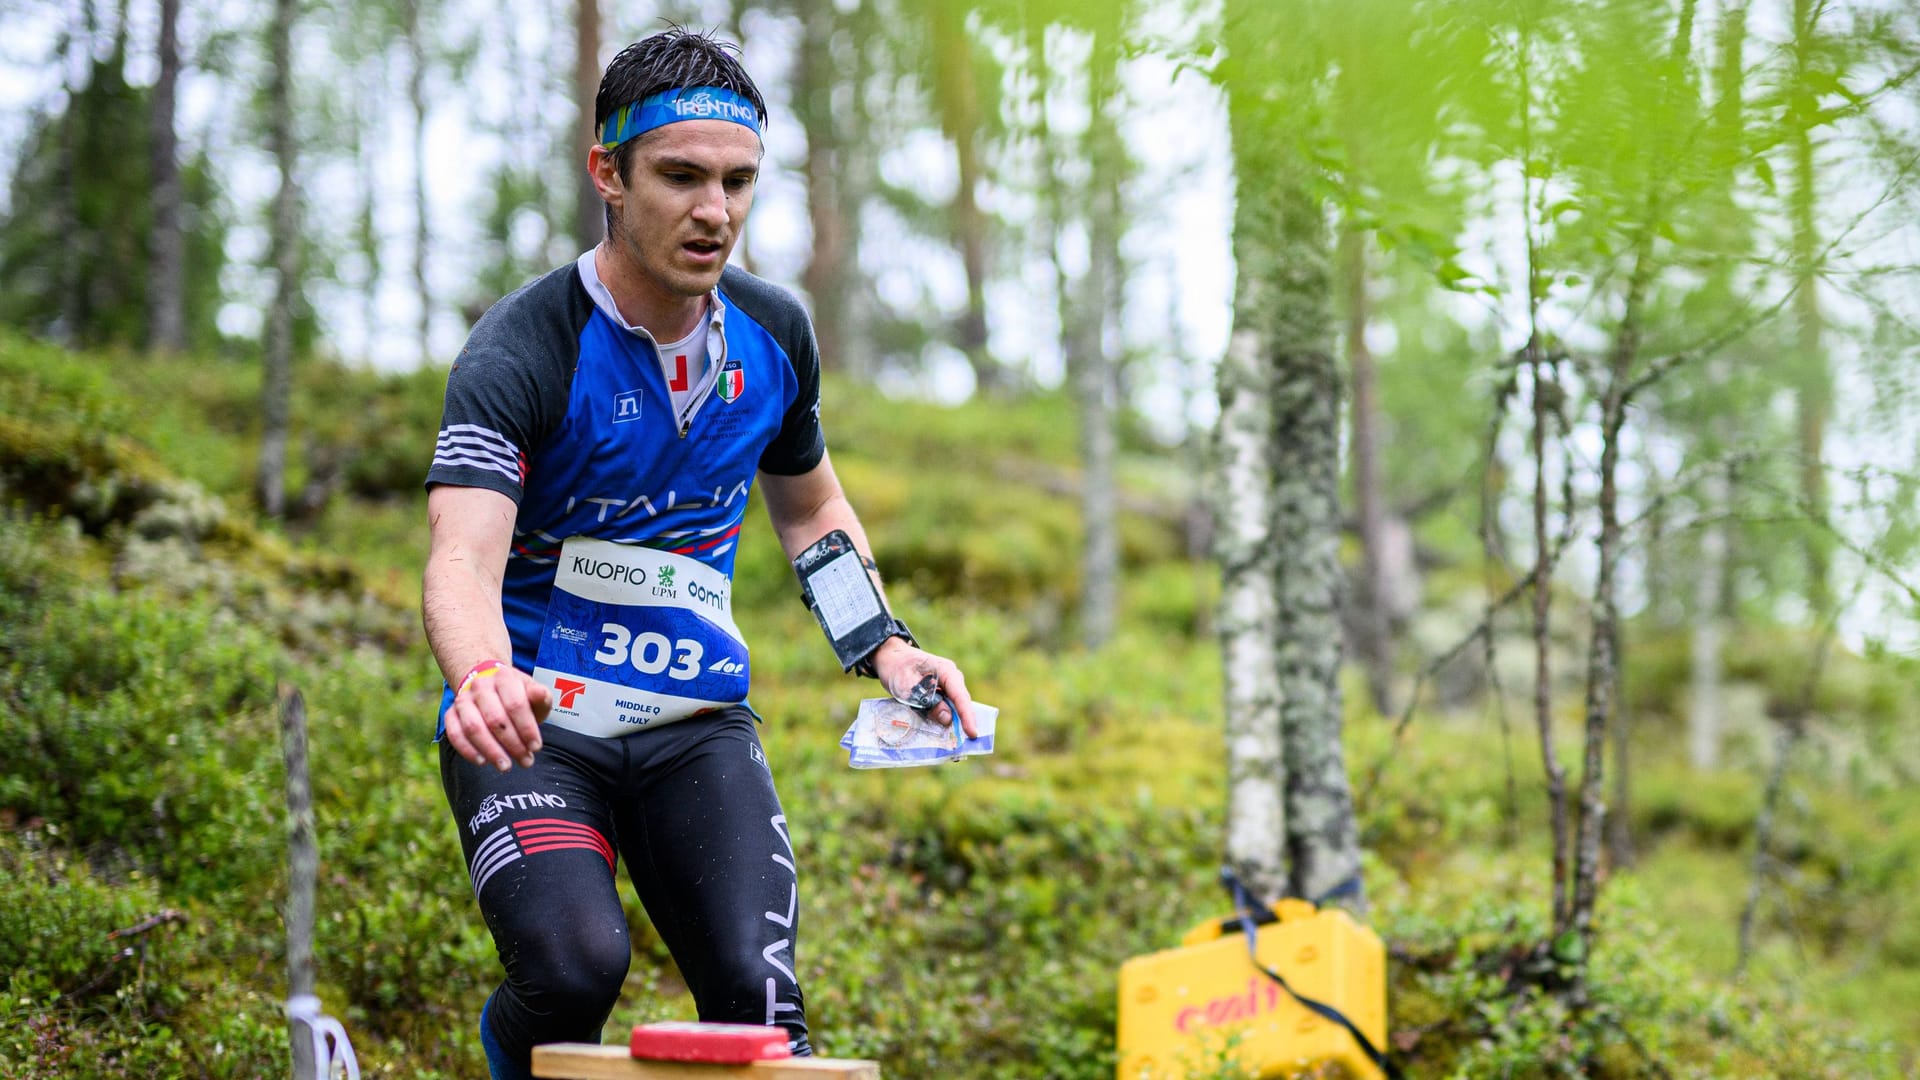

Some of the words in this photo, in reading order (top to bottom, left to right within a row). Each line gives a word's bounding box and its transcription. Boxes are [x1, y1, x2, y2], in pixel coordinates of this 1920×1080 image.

[672, 96, 752, 120] TRENTINO
[566, 480, 748, 522] ITALIA
[573, 557, 646, 585] KUOPIO
[652, 587, 677, 599] UPM
[688, 581, 724, 611] oomi
[595, 623, 704, 681] 303
[615, 699, 652, 713] MIDDLE
[654, 706, 661, 715] Q
[619, 715, 625, 723] 8
[628, 716, 650, 725] JULY
[469, 790, 567, 836] TRENTINO
[762, 815, 798, 1050] TALIA
